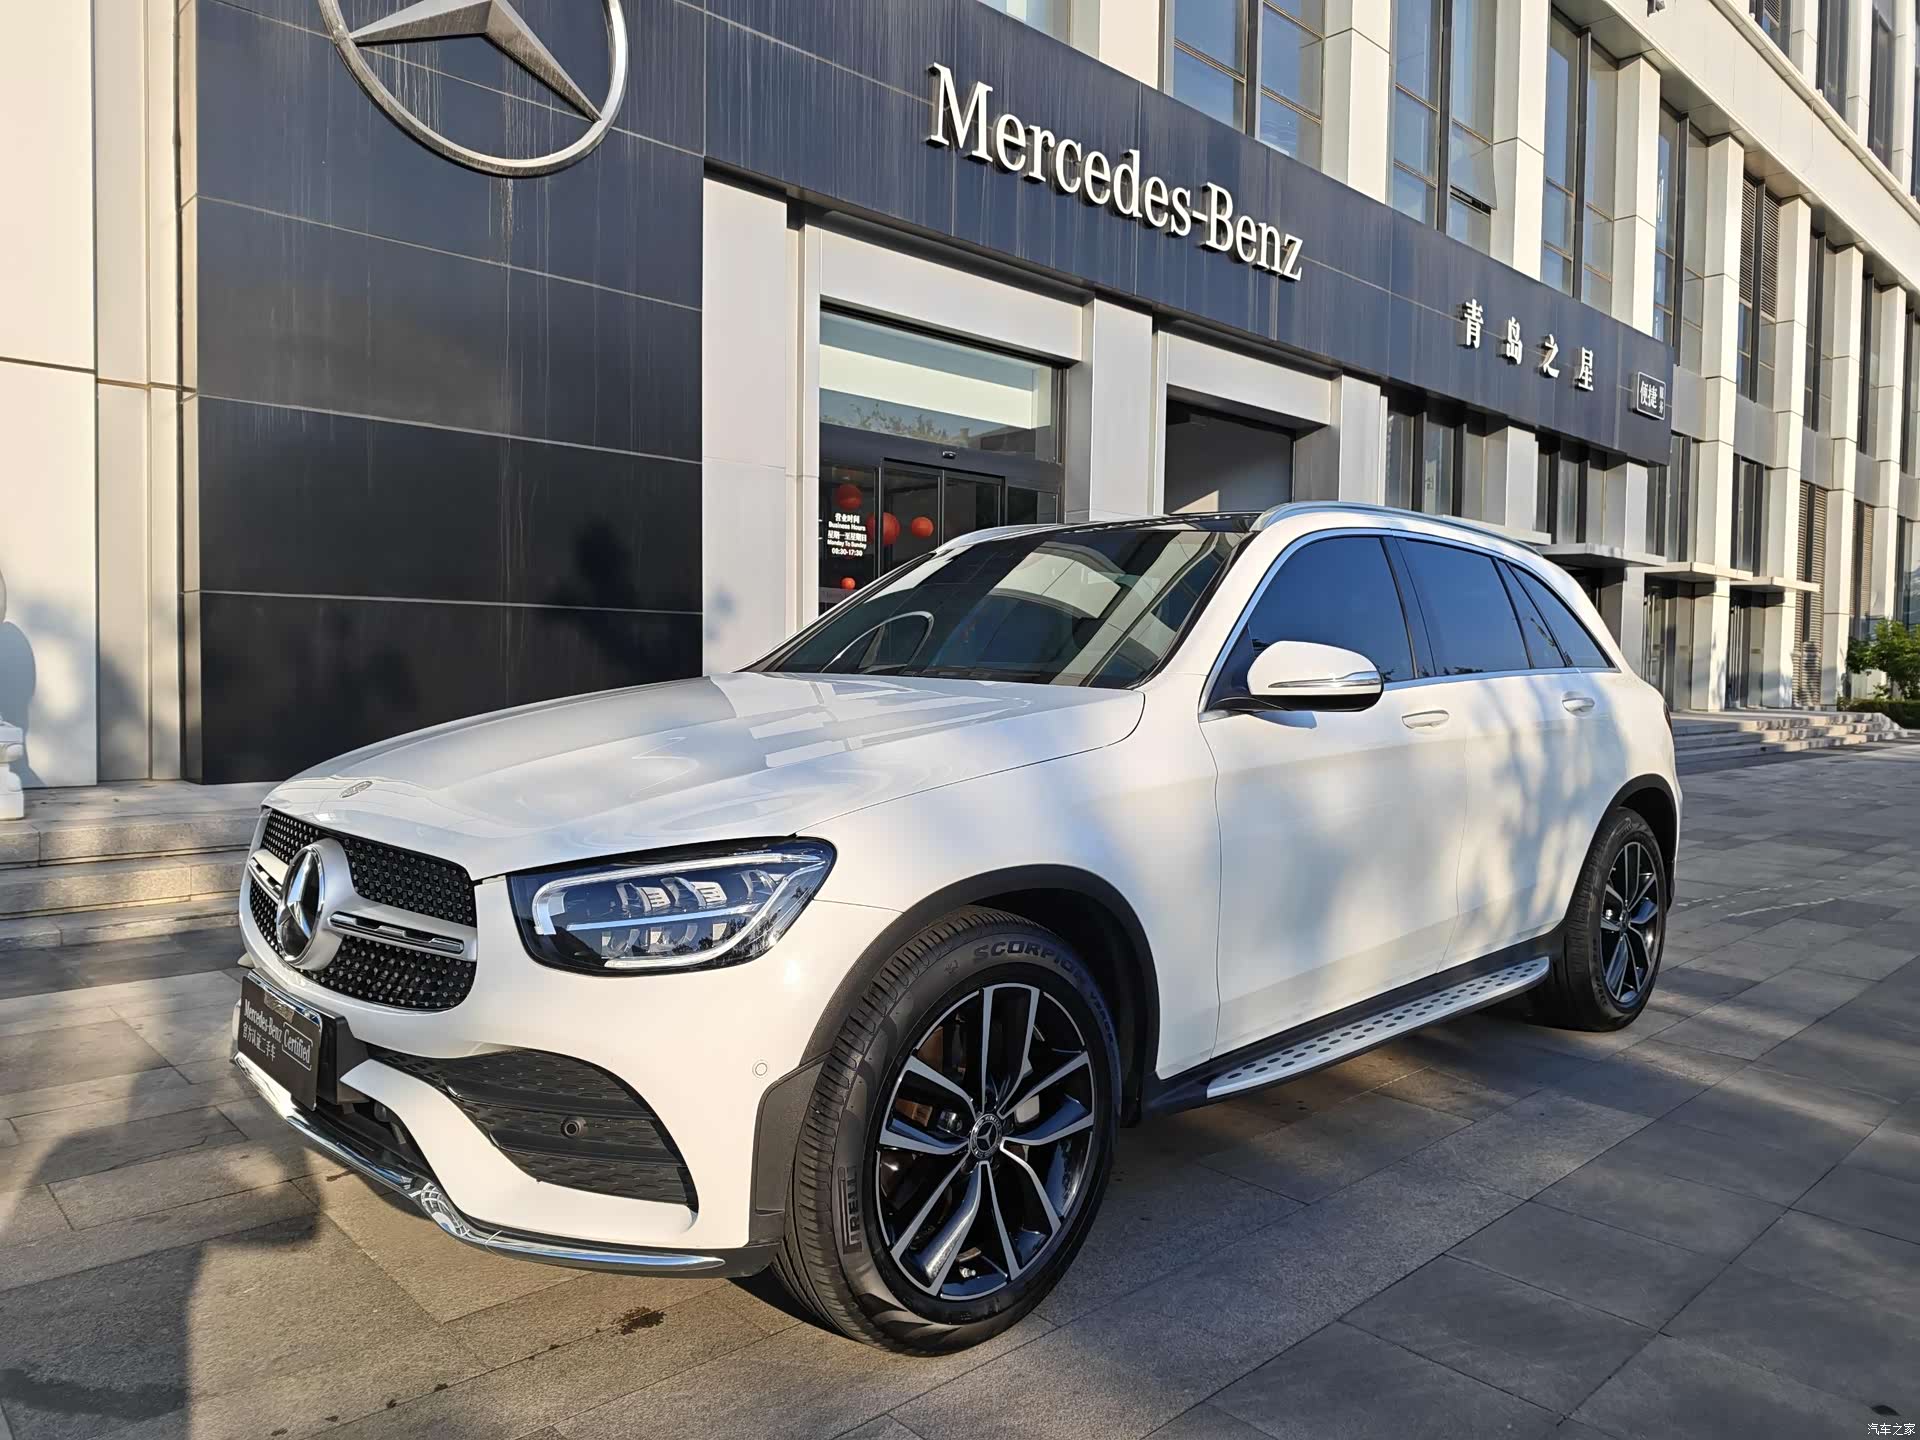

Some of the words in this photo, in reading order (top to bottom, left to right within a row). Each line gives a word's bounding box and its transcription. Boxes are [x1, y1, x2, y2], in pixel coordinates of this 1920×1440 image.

[927, 61, 1303, 282] Mercedes-Benz
[1463, 298, 1594, 391] 青岛之星
[1640, 380, 1658, 409] 便捷
[851, 523, 866, 532] Hours
[242, 1021, 276, 1061] 官方认证二手车
[243, 998, 283, 1043] Mercedes-Benz
[283, 1029, 311, 1064] Certified
